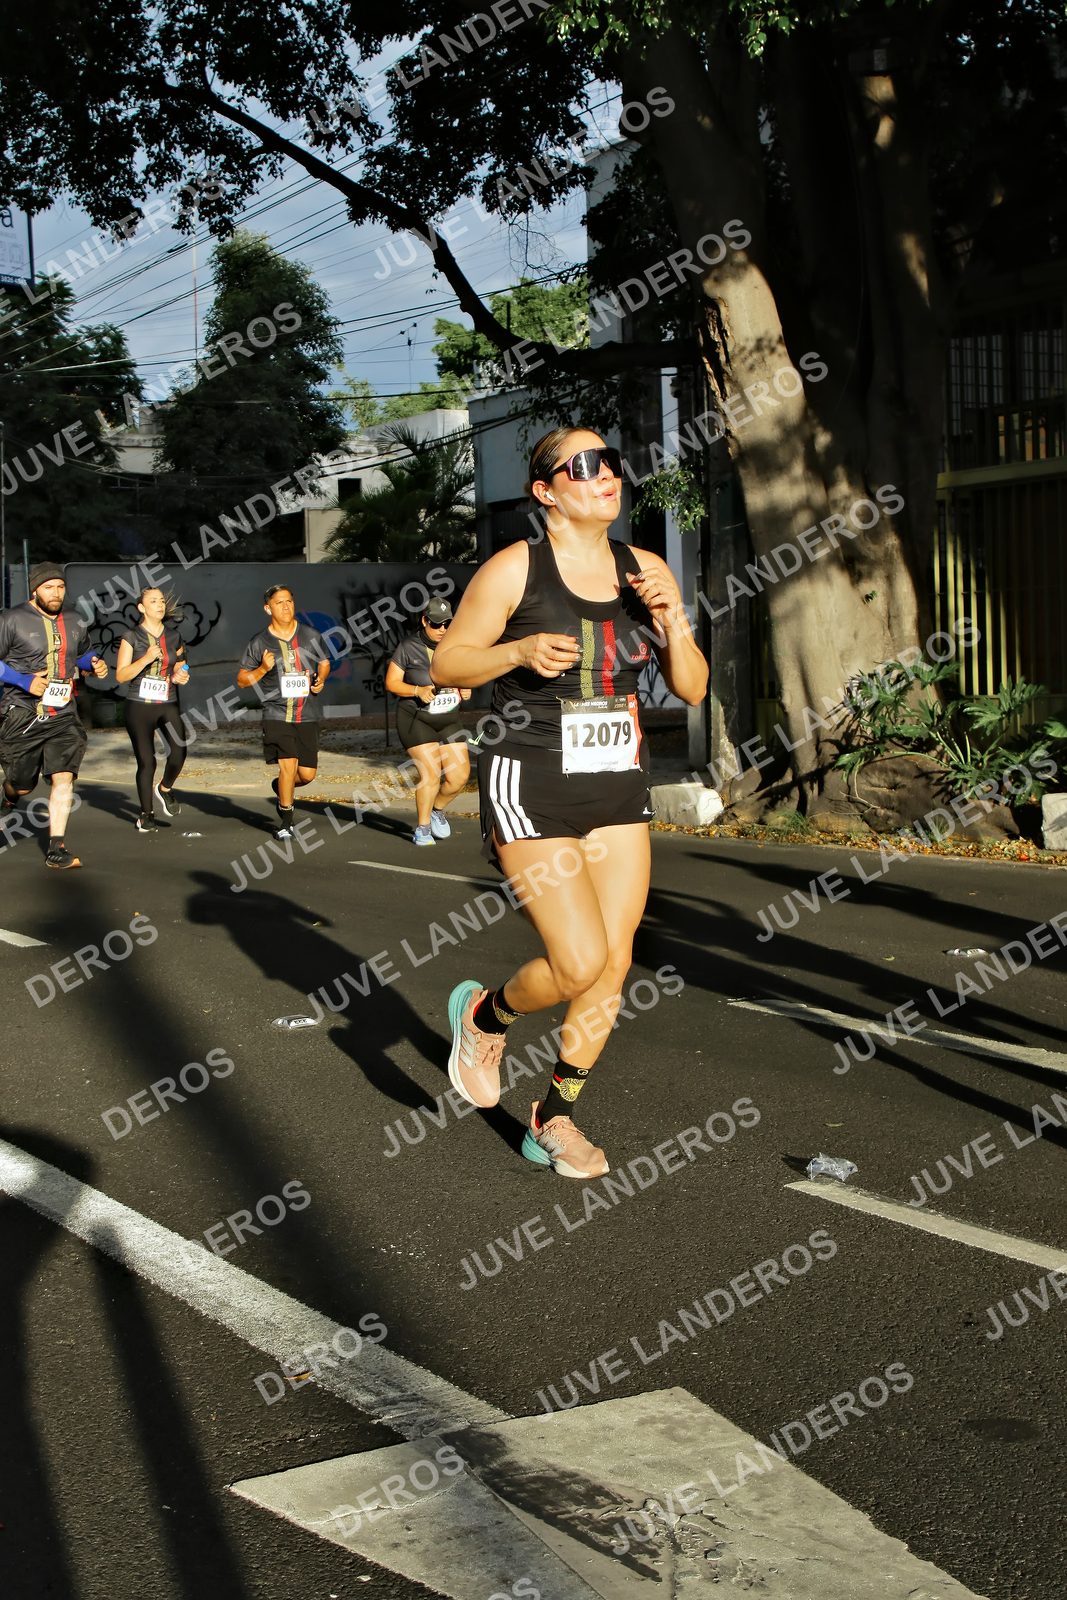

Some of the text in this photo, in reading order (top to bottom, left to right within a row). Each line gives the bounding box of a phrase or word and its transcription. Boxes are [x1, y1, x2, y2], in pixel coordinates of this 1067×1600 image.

[144, 682, 166, 692] 11673
[286, 679, 306, 688] 8908
[49, 687, 68, 696] 8247
[432, 696, 456, 706] 13391
[567, 720, 631, 748] 12079
